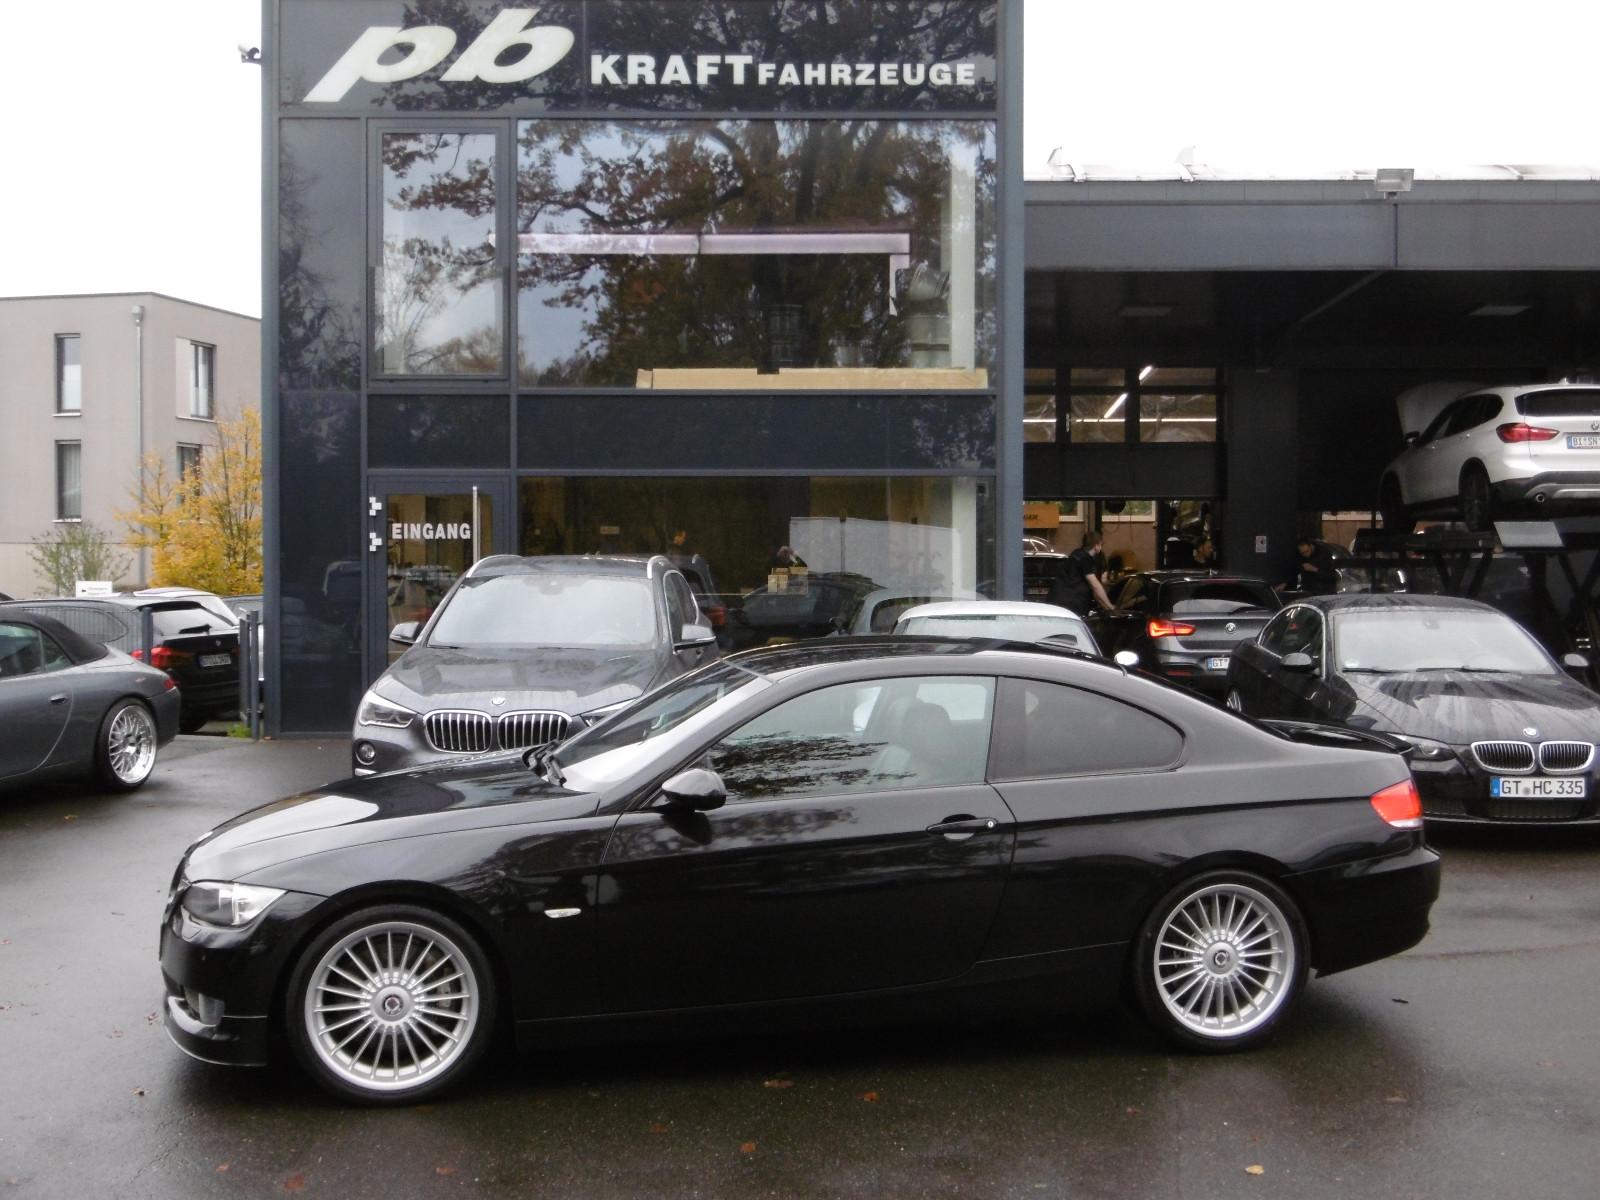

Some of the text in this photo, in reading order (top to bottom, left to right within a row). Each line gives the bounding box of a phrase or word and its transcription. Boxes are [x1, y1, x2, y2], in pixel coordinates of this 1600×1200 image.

[302, 8, 575, 102] pb
[391, 523, 471, 540] EINGANG
[1212, 658, 1224, 668] GT
[1501, 780, 1583, 795] GT HC 335
